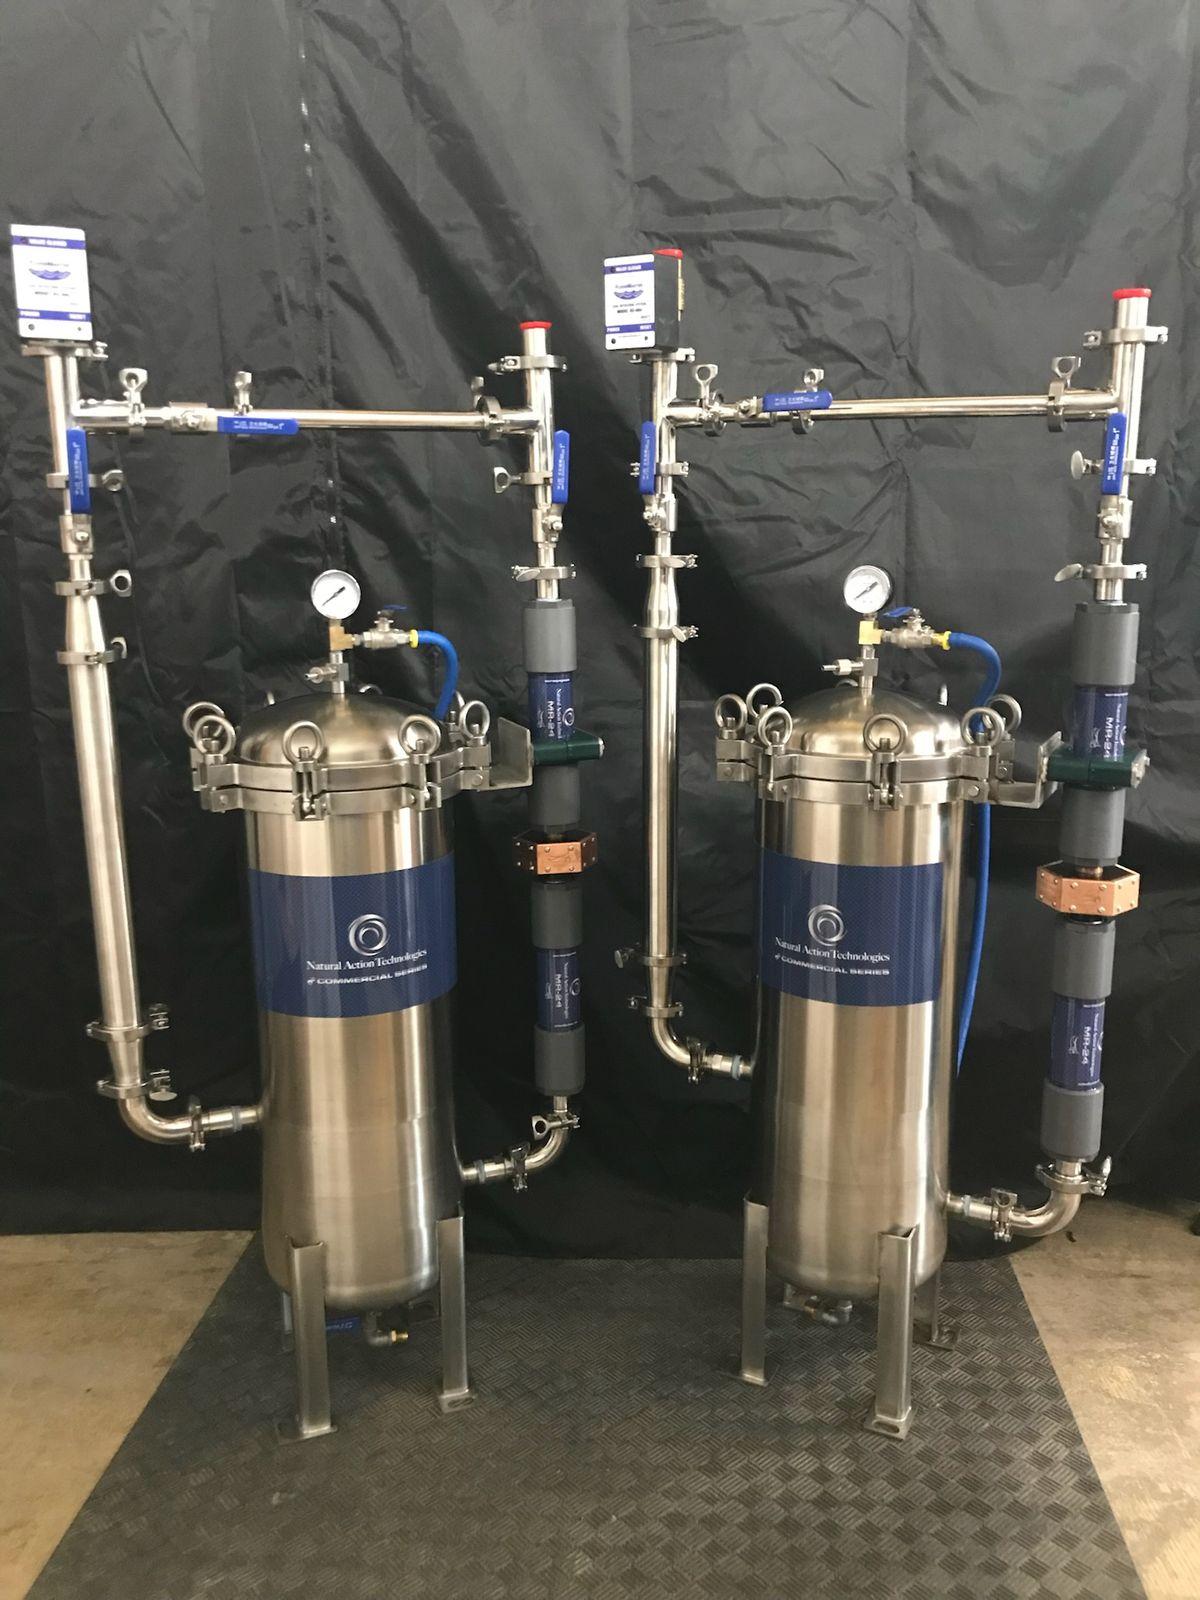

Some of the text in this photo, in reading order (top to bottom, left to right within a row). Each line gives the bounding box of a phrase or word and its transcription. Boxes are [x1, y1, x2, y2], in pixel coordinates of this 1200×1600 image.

[547, 700, 555, 737] MR-24
[1104, 717, 1114, 758] MR-24
[306, 949, 428, 971] Natural Action Technologies
[775, 936, 891, 964] Natural Action Technologies
[316, 963, 428, 985] COMMERCIAL SERIES
[781, 955, 890, 976] COMMERCIAL SERIES
[1081, 1026, 1092, 1065] MR-24
